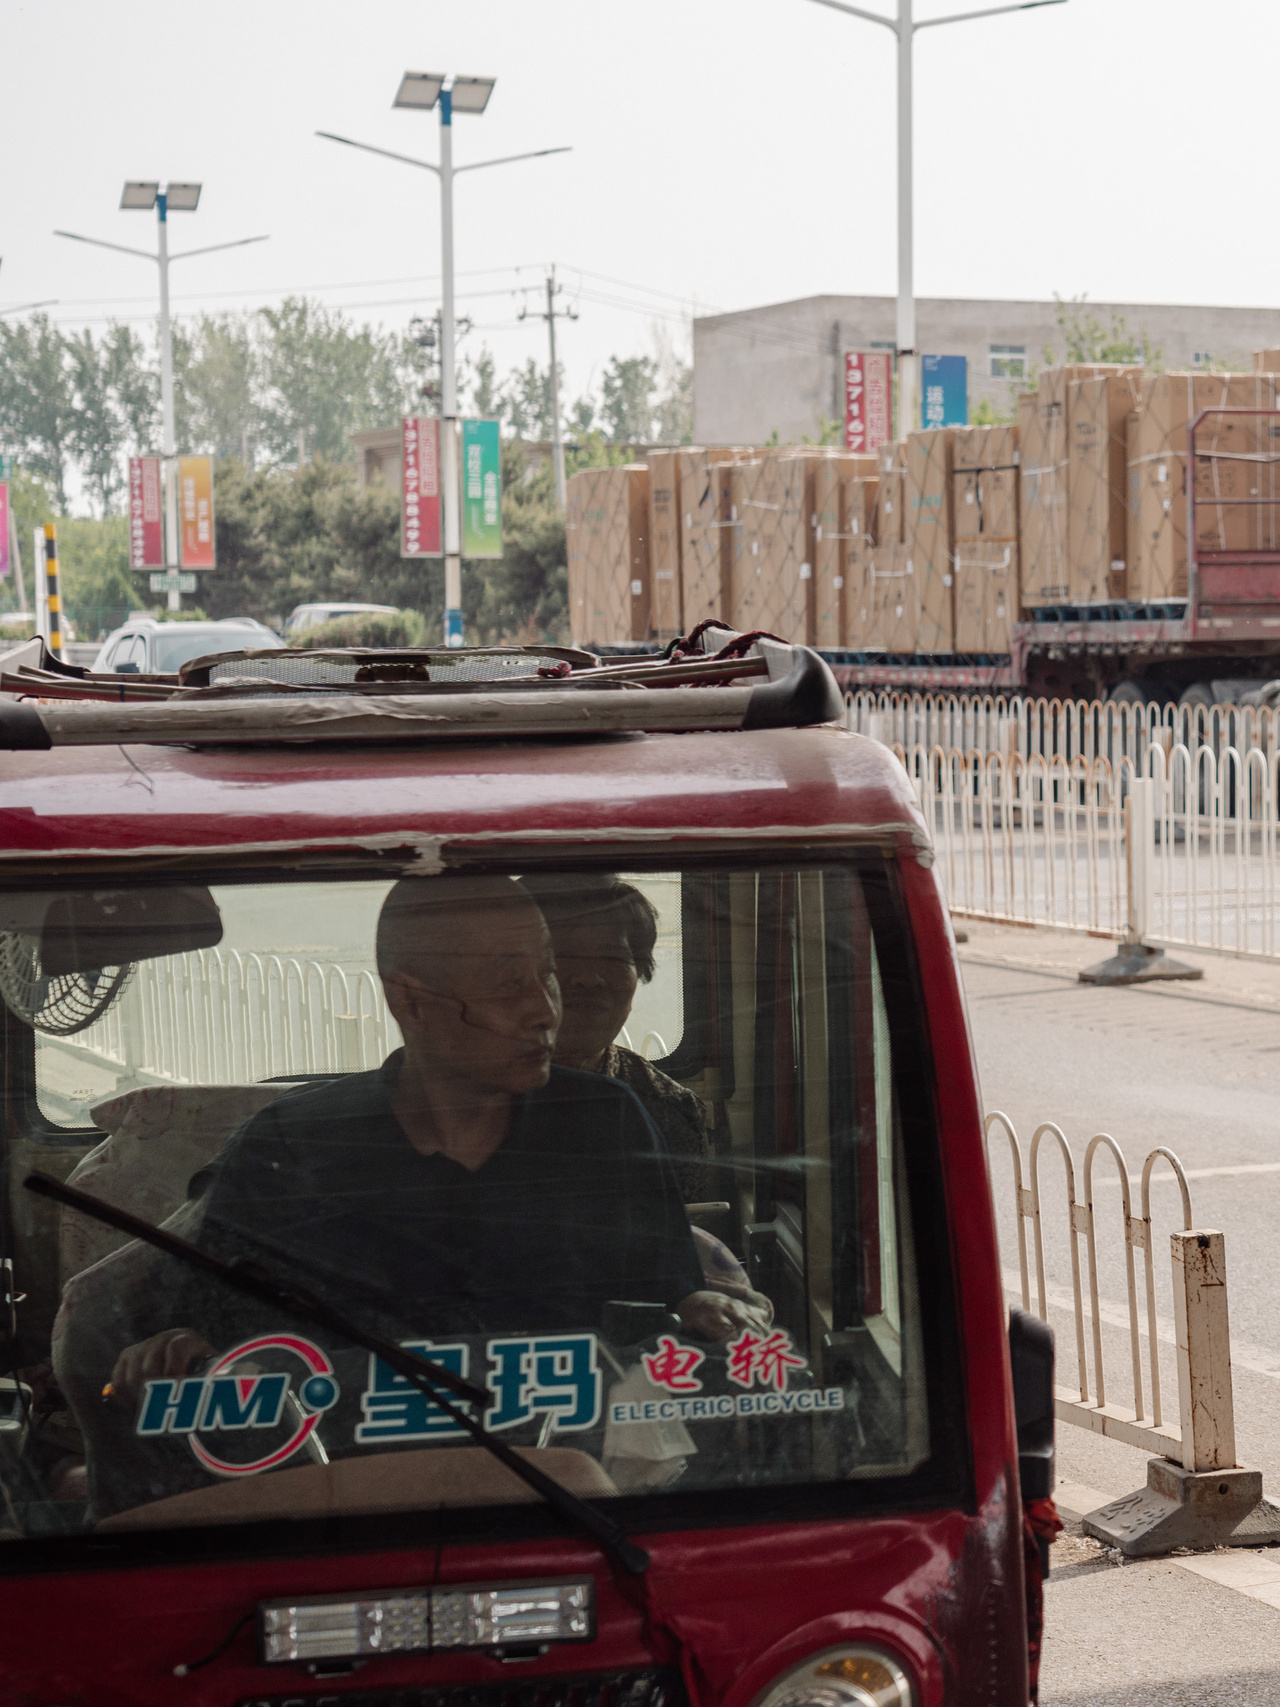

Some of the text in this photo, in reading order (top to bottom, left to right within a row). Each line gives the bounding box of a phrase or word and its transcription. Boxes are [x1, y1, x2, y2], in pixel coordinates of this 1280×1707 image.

[640, 1327, 808, 1393] 电轿
[136, 1372, 292, 1436] HM
[611, 1387, 844, 1425] ELECTRIC BICYCLE
